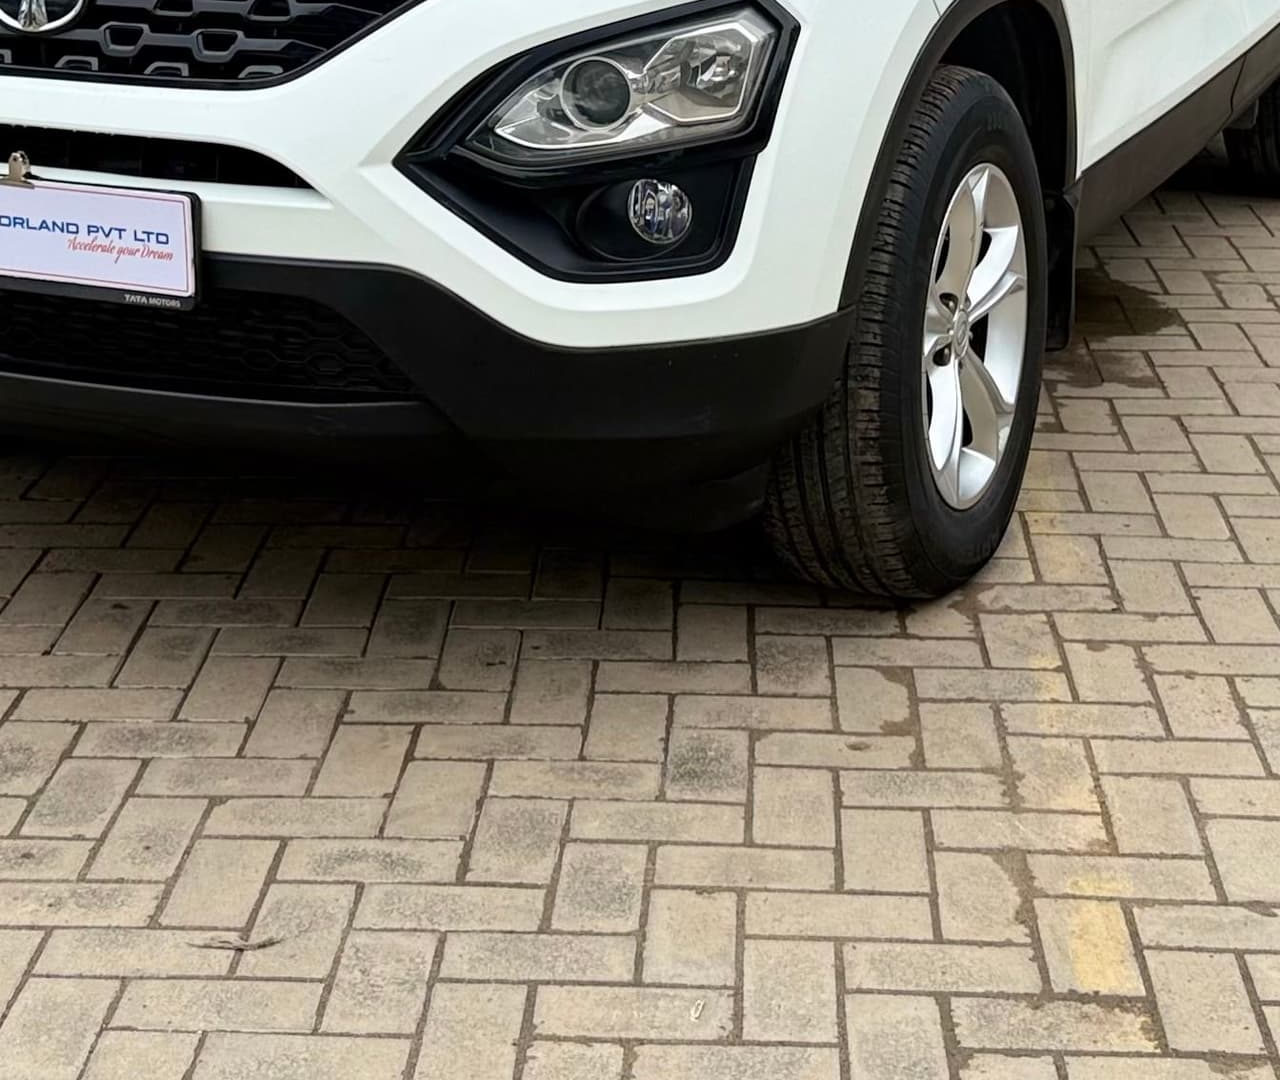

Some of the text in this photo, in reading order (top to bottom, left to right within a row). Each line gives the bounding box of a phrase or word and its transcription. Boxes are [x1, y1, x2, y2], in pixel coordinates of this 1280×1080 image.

[87, 224, 127, 240] PVT
[134, 230, 169, 245] LTD
[68, 235, 174, 264] Accelerate your Dream
[124, 294, 181, 308] TATA MOTORS
